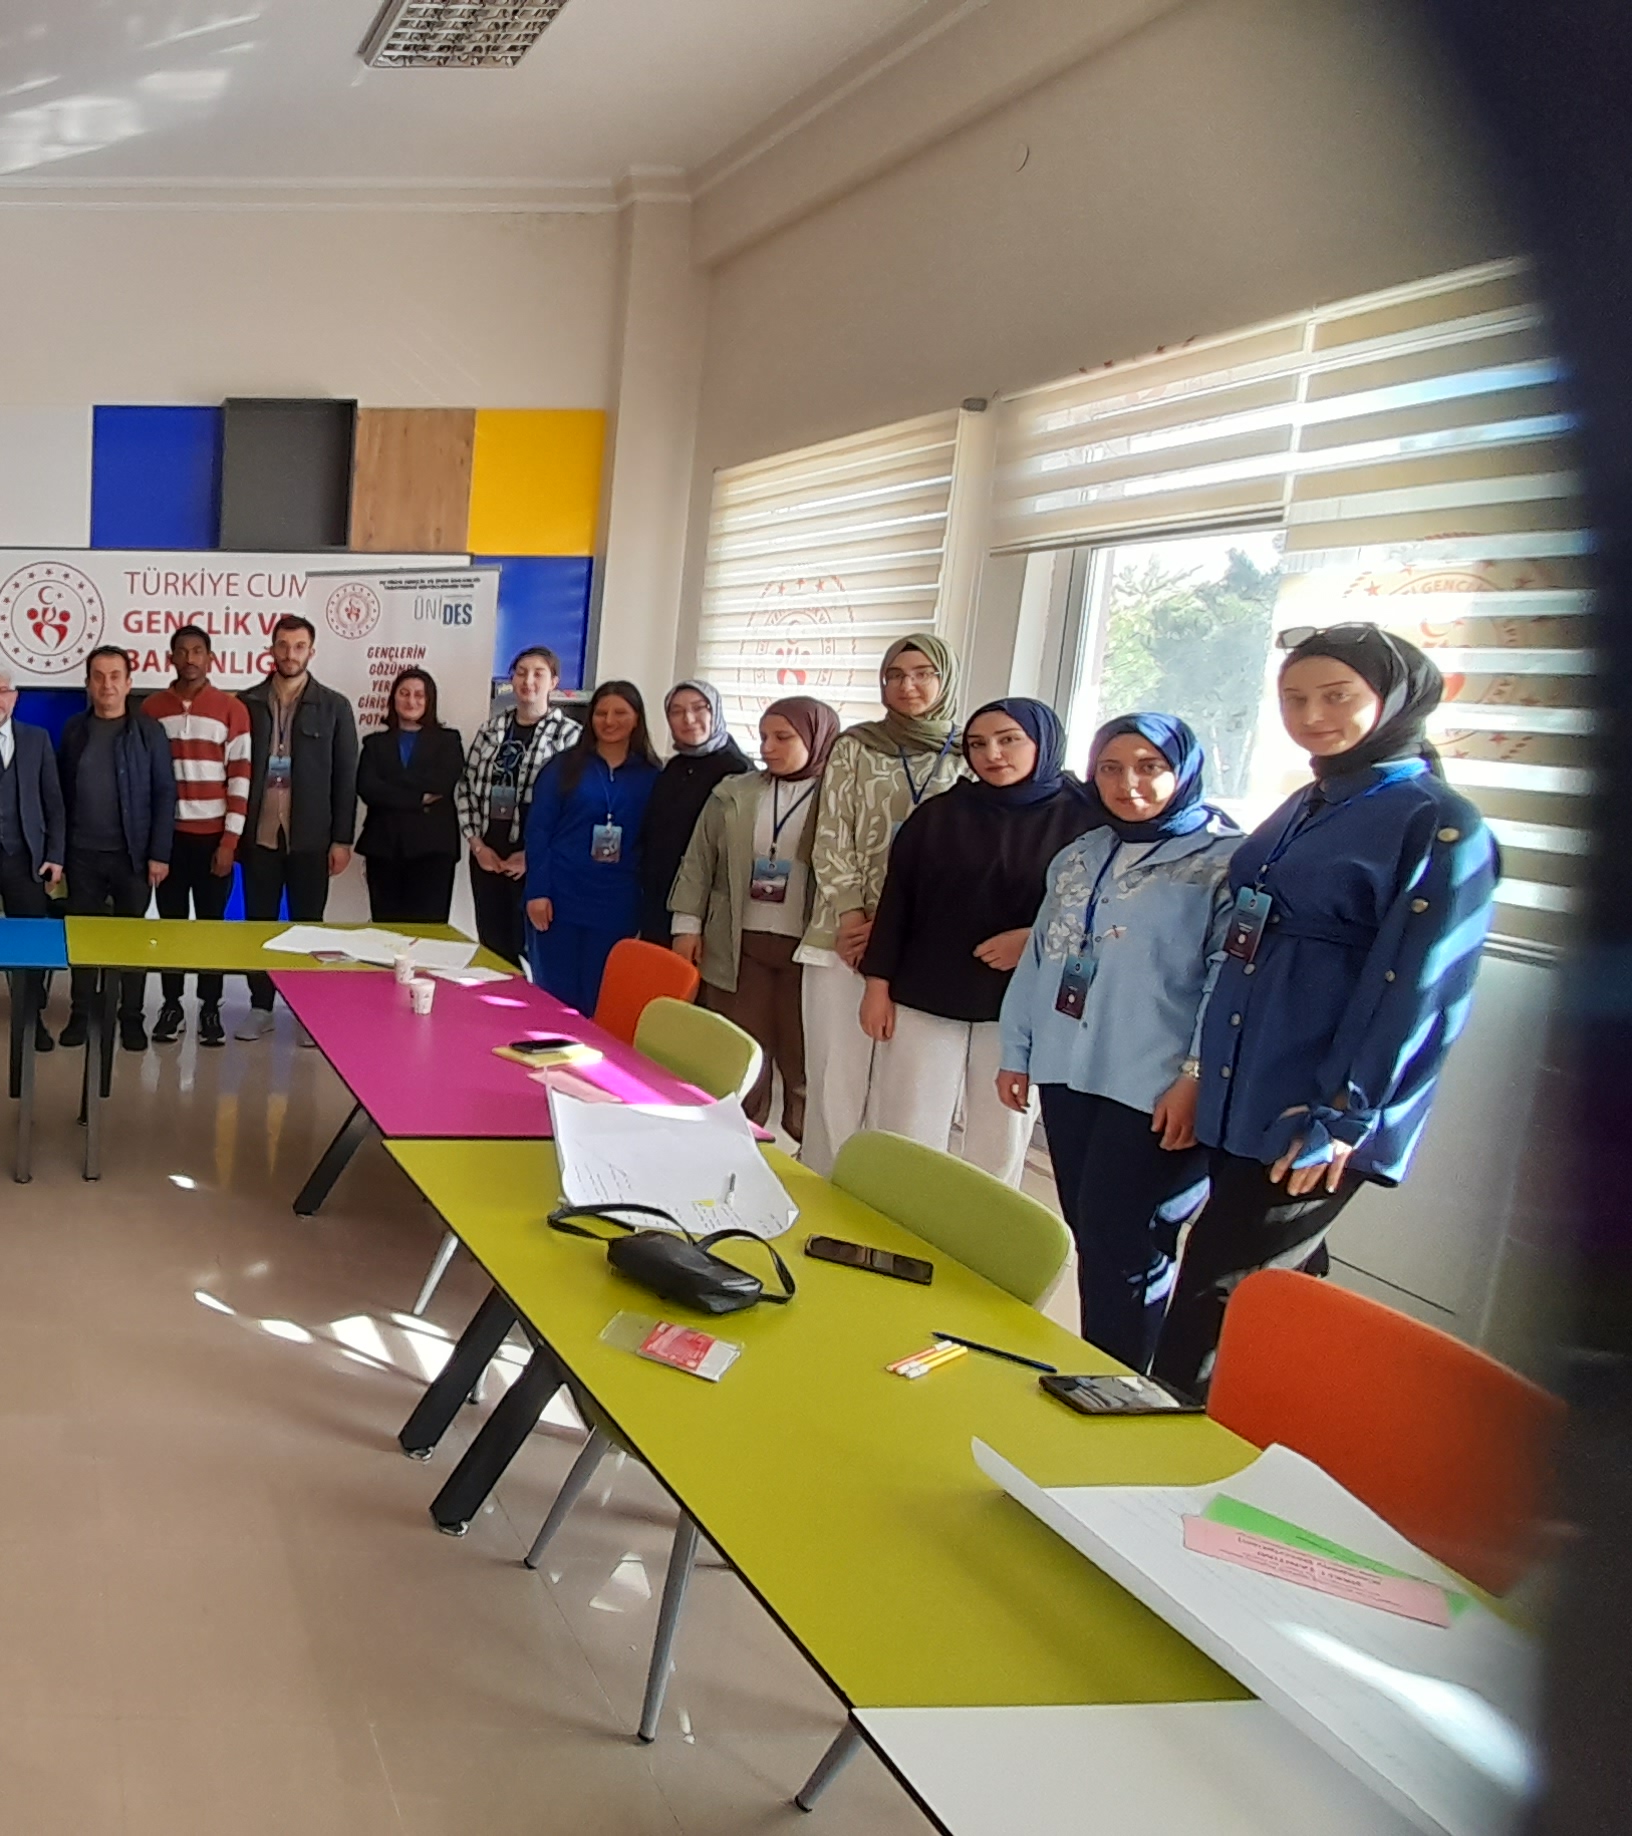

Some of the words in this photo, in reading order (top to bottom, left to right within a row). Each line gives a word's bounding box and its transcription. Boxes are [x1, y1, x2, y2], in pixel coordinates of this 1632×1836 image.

[124, 567, 240, 597] TÜRKİYE
[257, 612, 295, 635] V
[367, 644, 426, 661] GENÇLERİN
[358, 694, 390, 711] GİRİŞ
